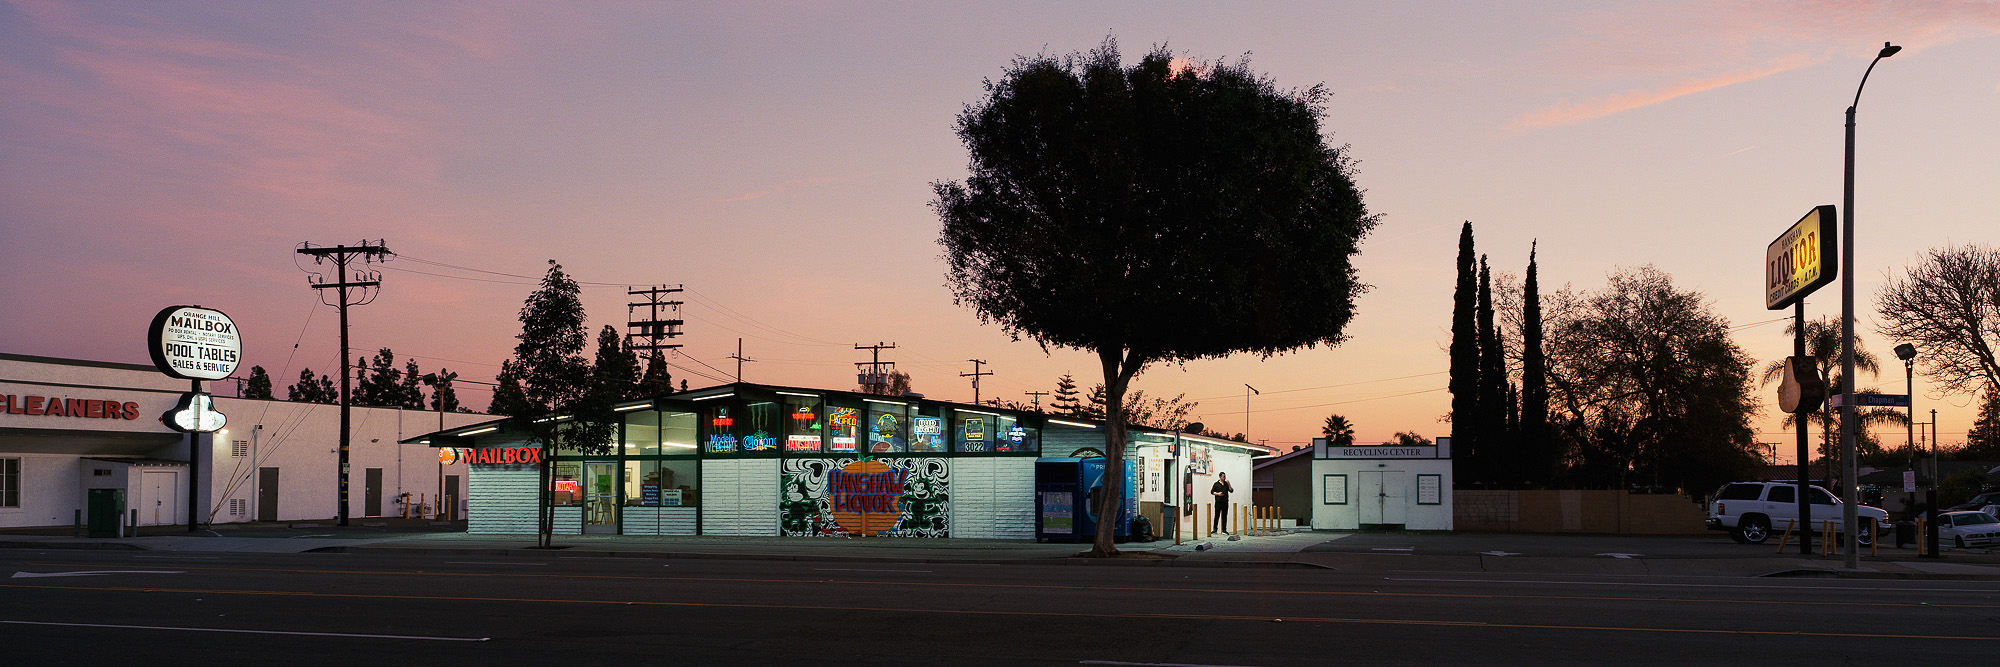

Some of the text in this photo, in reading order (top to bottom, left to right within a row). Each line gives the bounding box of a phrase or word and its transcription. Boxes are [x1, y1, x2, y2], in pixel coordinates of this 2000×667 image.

[1770, 230, 1816, 289] LIQUOR
[1769, 286, 1784, 303] CREDIT
[1785, 277, 1799, 294] CARDS
[183, 311, 207, 320] ORANGE
[171, 315, 232, 334] MAILBOX
[165, 342, 236, 363] POOL TABLES
[172, 359, 230, 373] SALES & SERVICE
[1868, 396, 1895, 405] Chapman
[915, 425, 940, 434] LIGHT
[918, 419, 936, 427] BUD
[710, 433, 735, 444] Modelo
[965, 442, 984, 452] 3022
[1343, 448, 1421, 456] RECYCLING CENTER
[461, 447, 541, 464] MAILBOX
[829, 469, 908, 494] HANSHAW
[1151, 472, 1160, 492] EBT
[834, 493, 896, 514] LIQUOR
